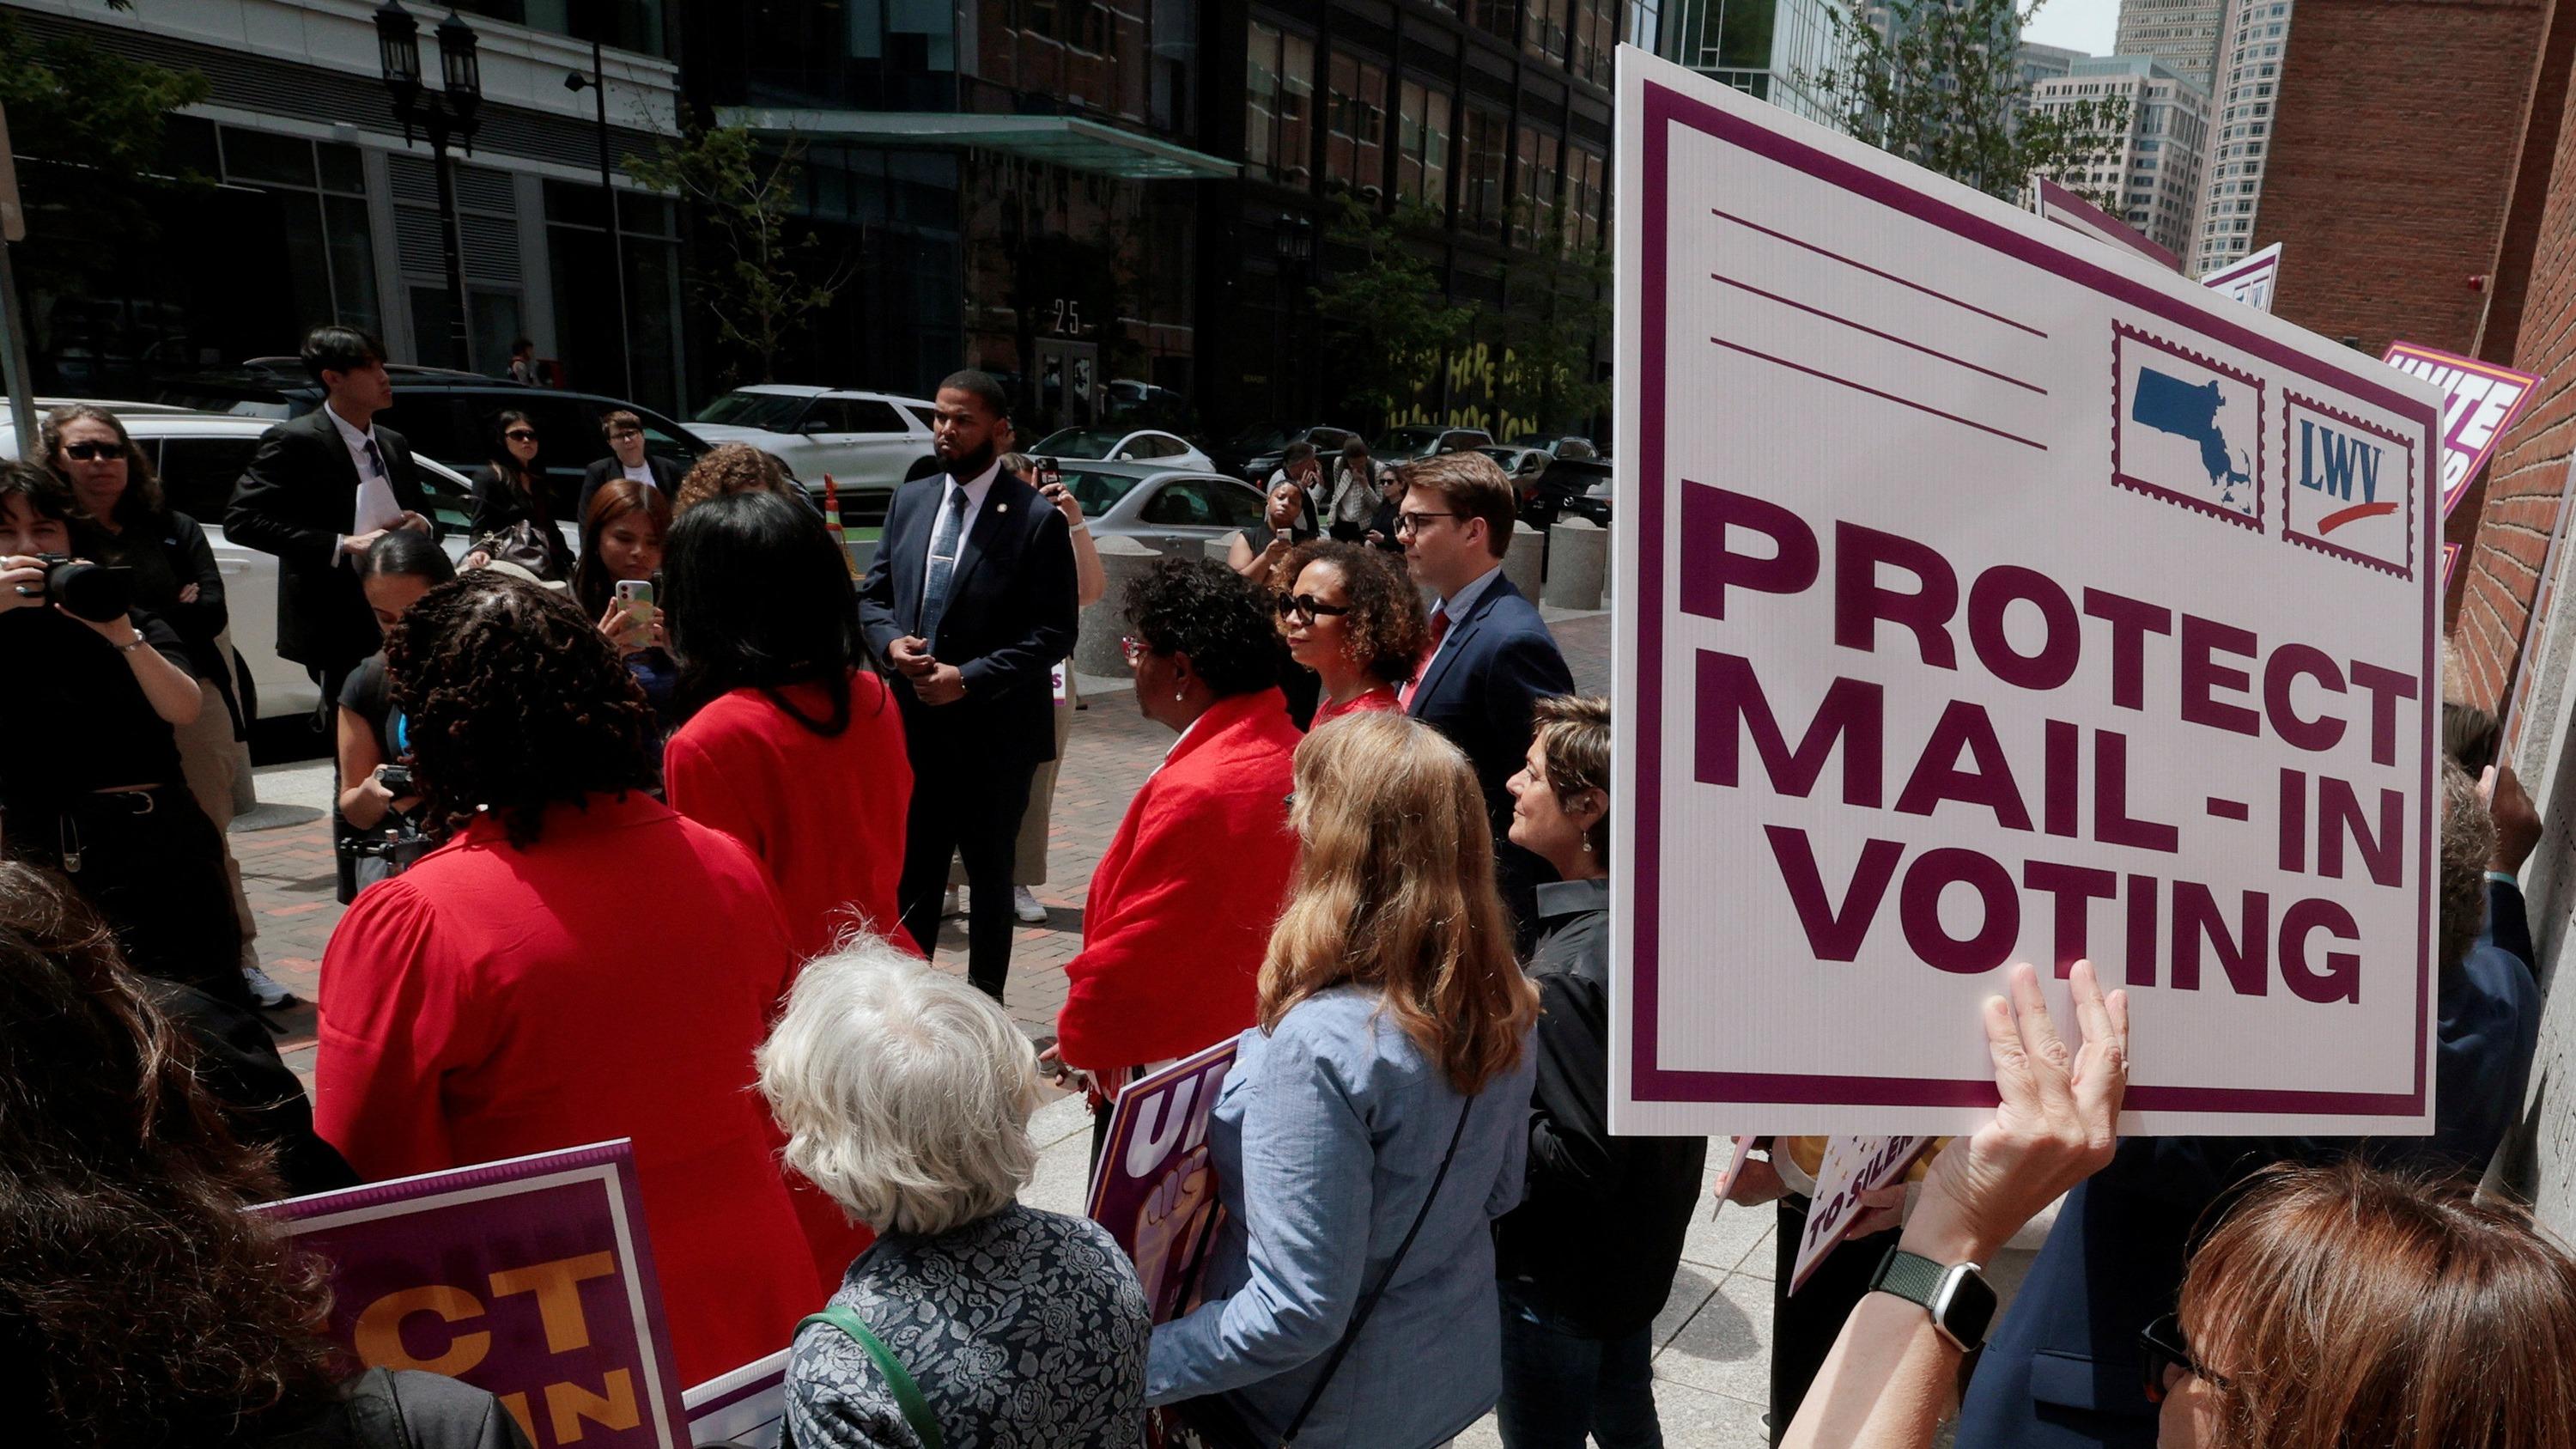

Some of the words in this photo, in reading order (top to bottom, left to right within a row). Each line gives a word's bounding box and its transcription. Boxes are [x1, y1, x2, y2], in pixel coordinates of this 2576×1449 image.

[1054, 298, 1078, 334] 25
[2388, 354, 2523, 450] ITE
[2299, 418, 2383, 503] LWV
[1680, 478, 2418, 766] PROTECT
[1763, 825, 2360, 1004] VOTING
[1807, 1191, 1844, 1252] TO
